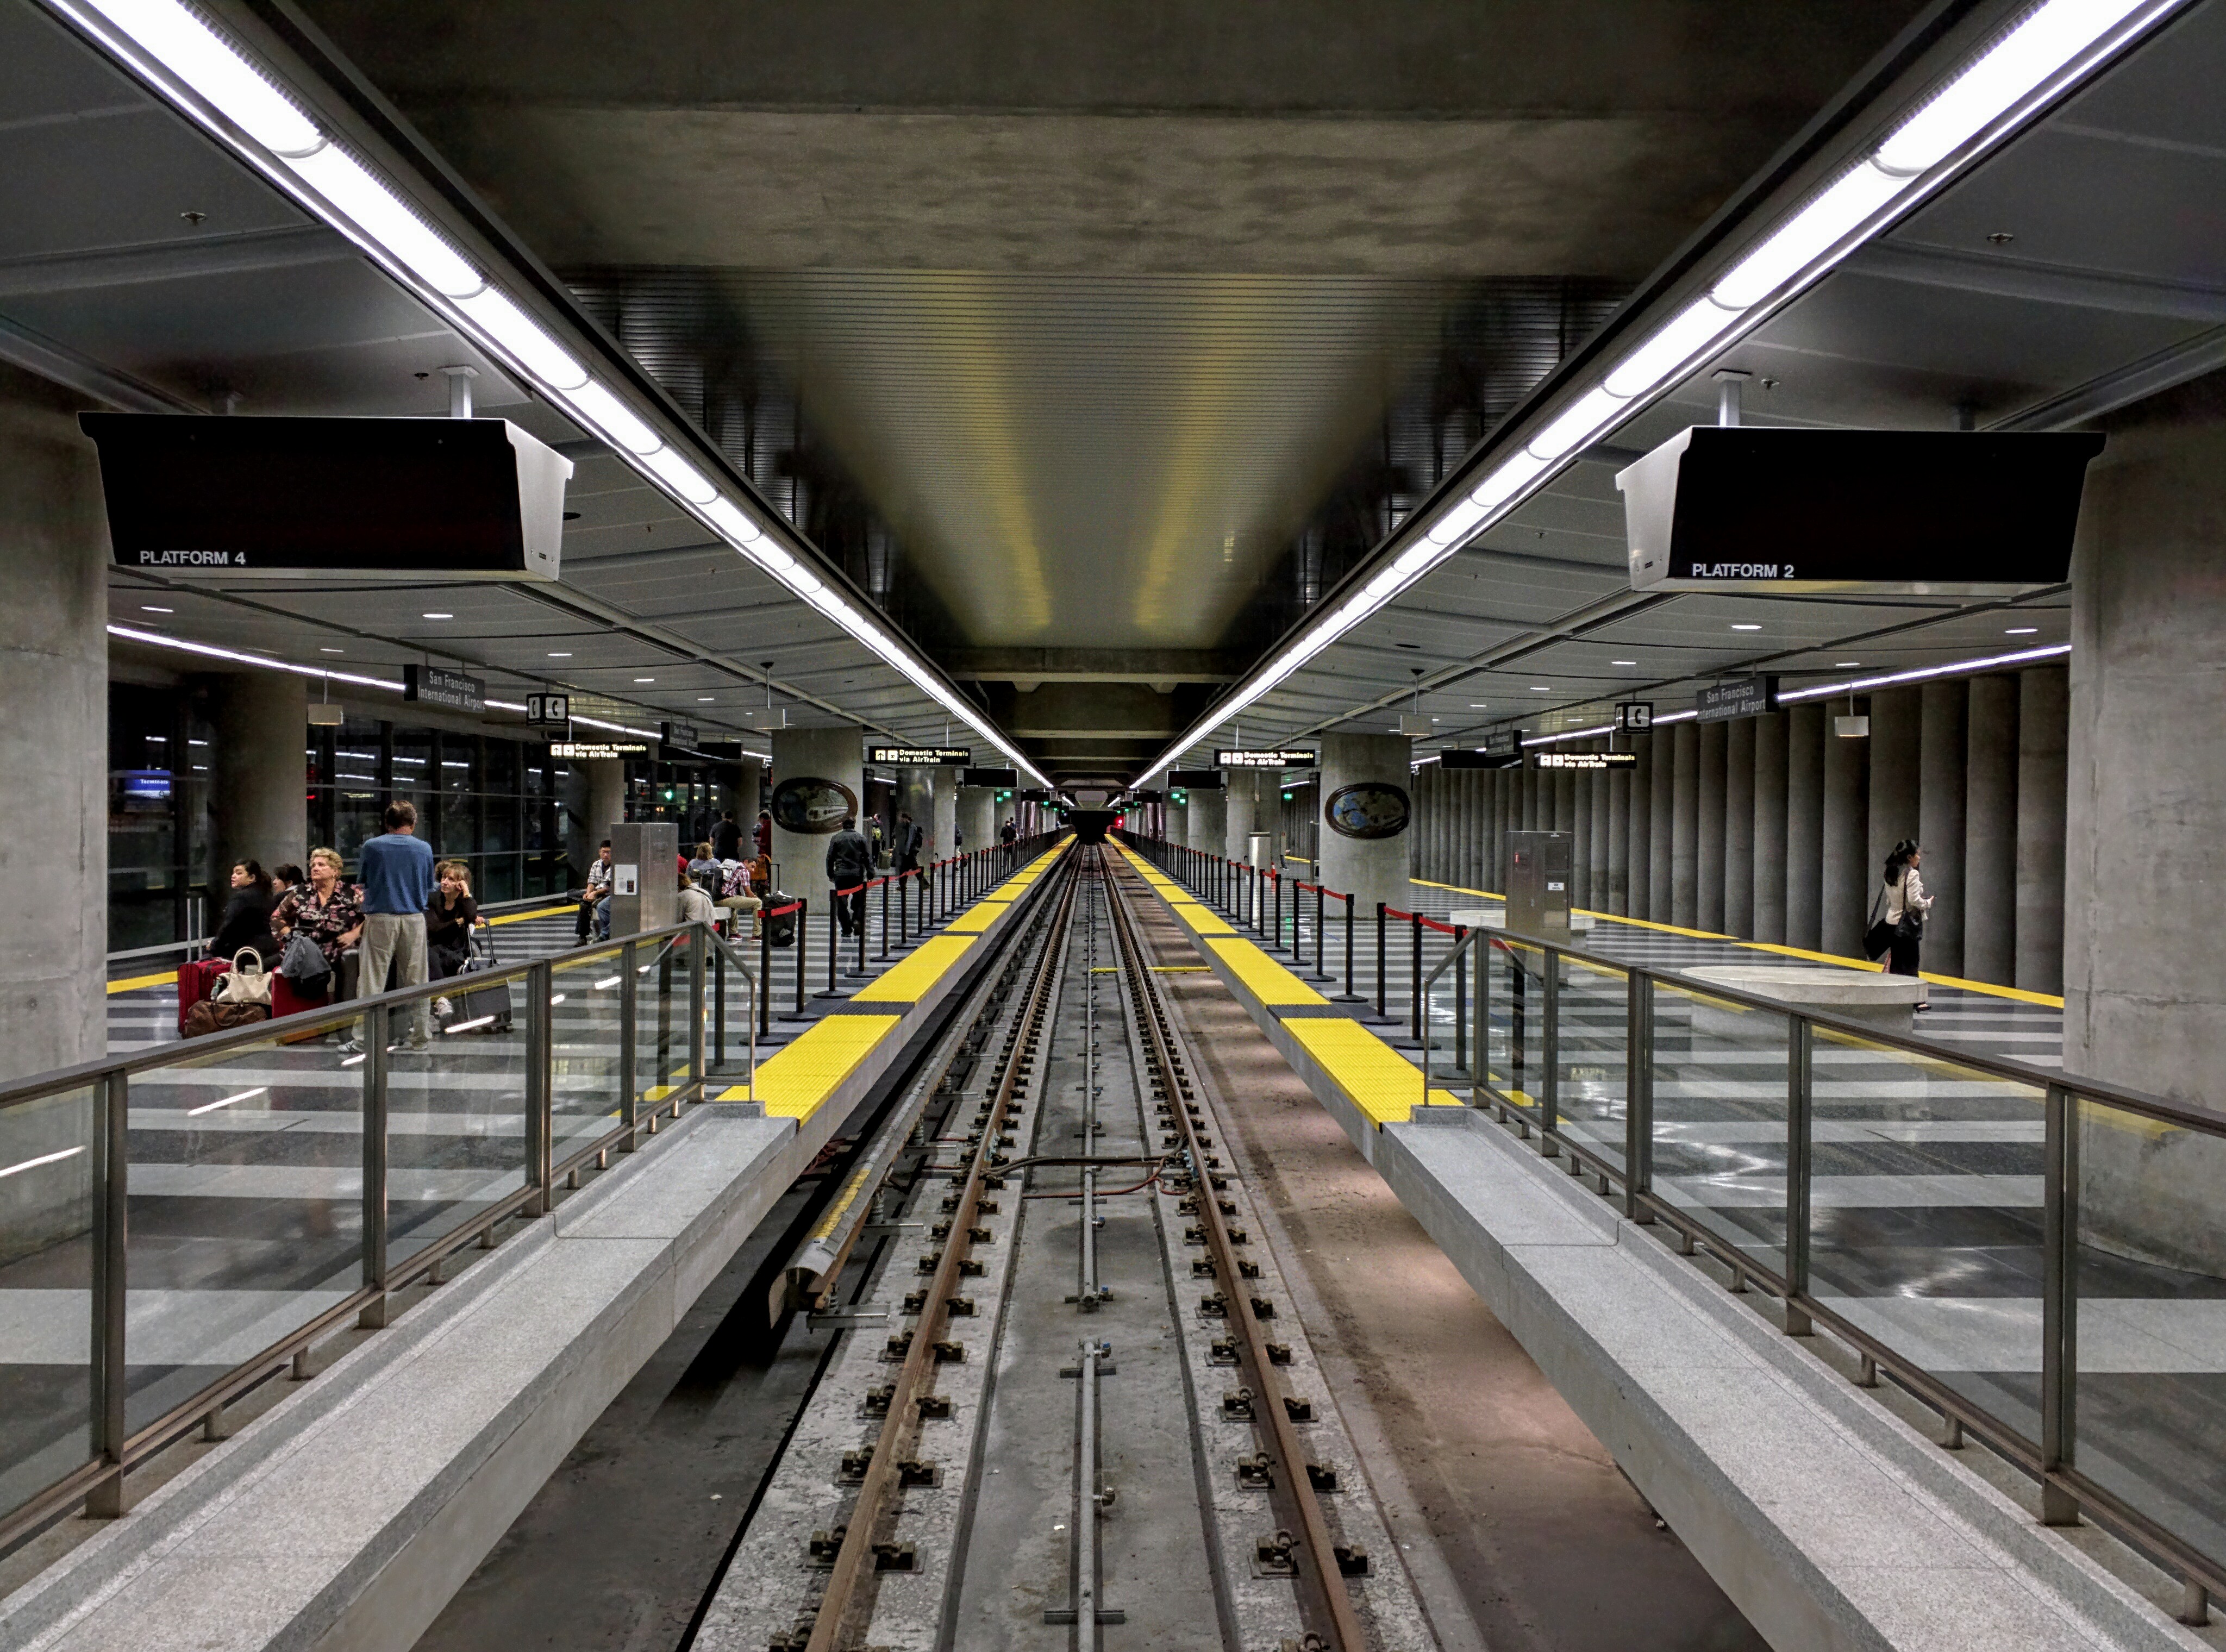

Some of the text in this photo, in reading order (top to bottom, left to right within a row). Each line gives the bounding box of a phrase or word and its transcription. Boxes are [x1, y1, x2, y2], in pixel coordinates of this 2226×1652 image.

[140, 550, 246, 565] PLATFORM 4
[1692, 563, 1794, 578] PLATFORM 2
[429, 671, 476, 692] San Francisco
[417, 685, 461, 705] International
[1706, 685, 1754, 703] San Francisco
[1741, 698, 1766, 714] Airport
